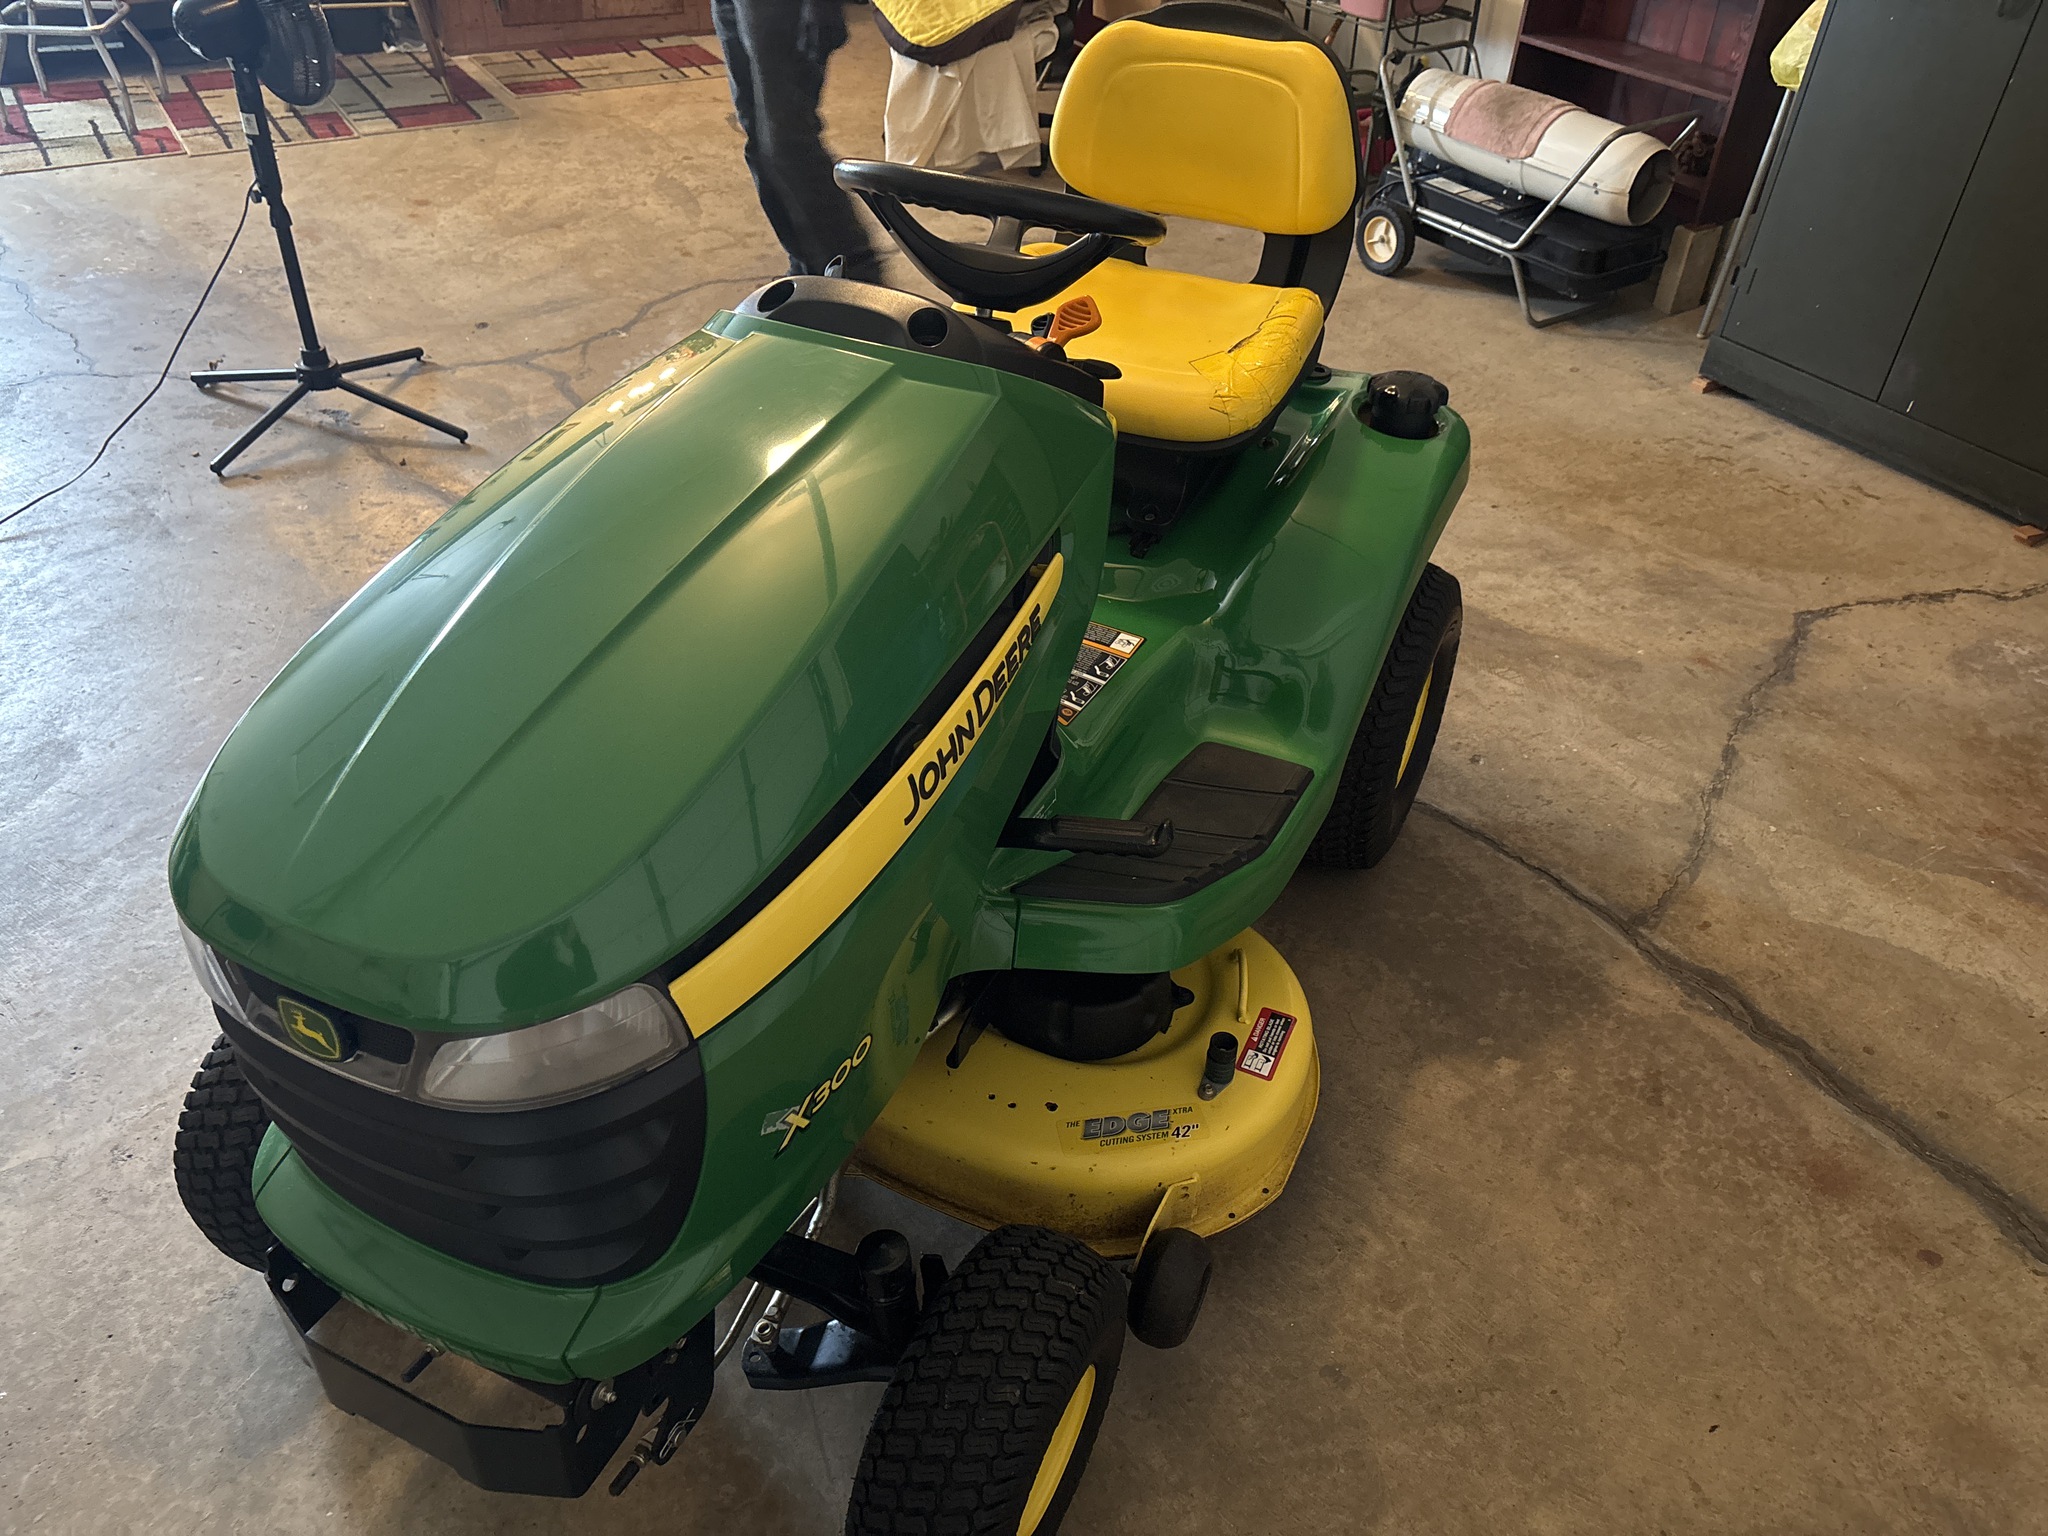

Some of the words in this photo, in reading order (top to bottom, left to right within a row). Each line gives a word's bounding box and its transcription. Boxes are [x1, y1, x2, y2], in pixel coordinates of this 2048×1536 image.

[904, 709, 976, 826] JOHN
[972, 603, 1042, 728] DEERE
[1252, 1017, 1267, 1036] DANGER
[773, 1032, 872, 1159] X300
[1066, 1120, 1081, 1128] THE
[1081, 1109, 1170, 1140] EDGE
[1172, 1106, 1193, 1115] XTRA
[1099, 1134, 1135, 1147] CUTTING
[1135, 1130, 1169, 1143] SYSTEM
[1171, 1123, 1199, 1139] 42"
